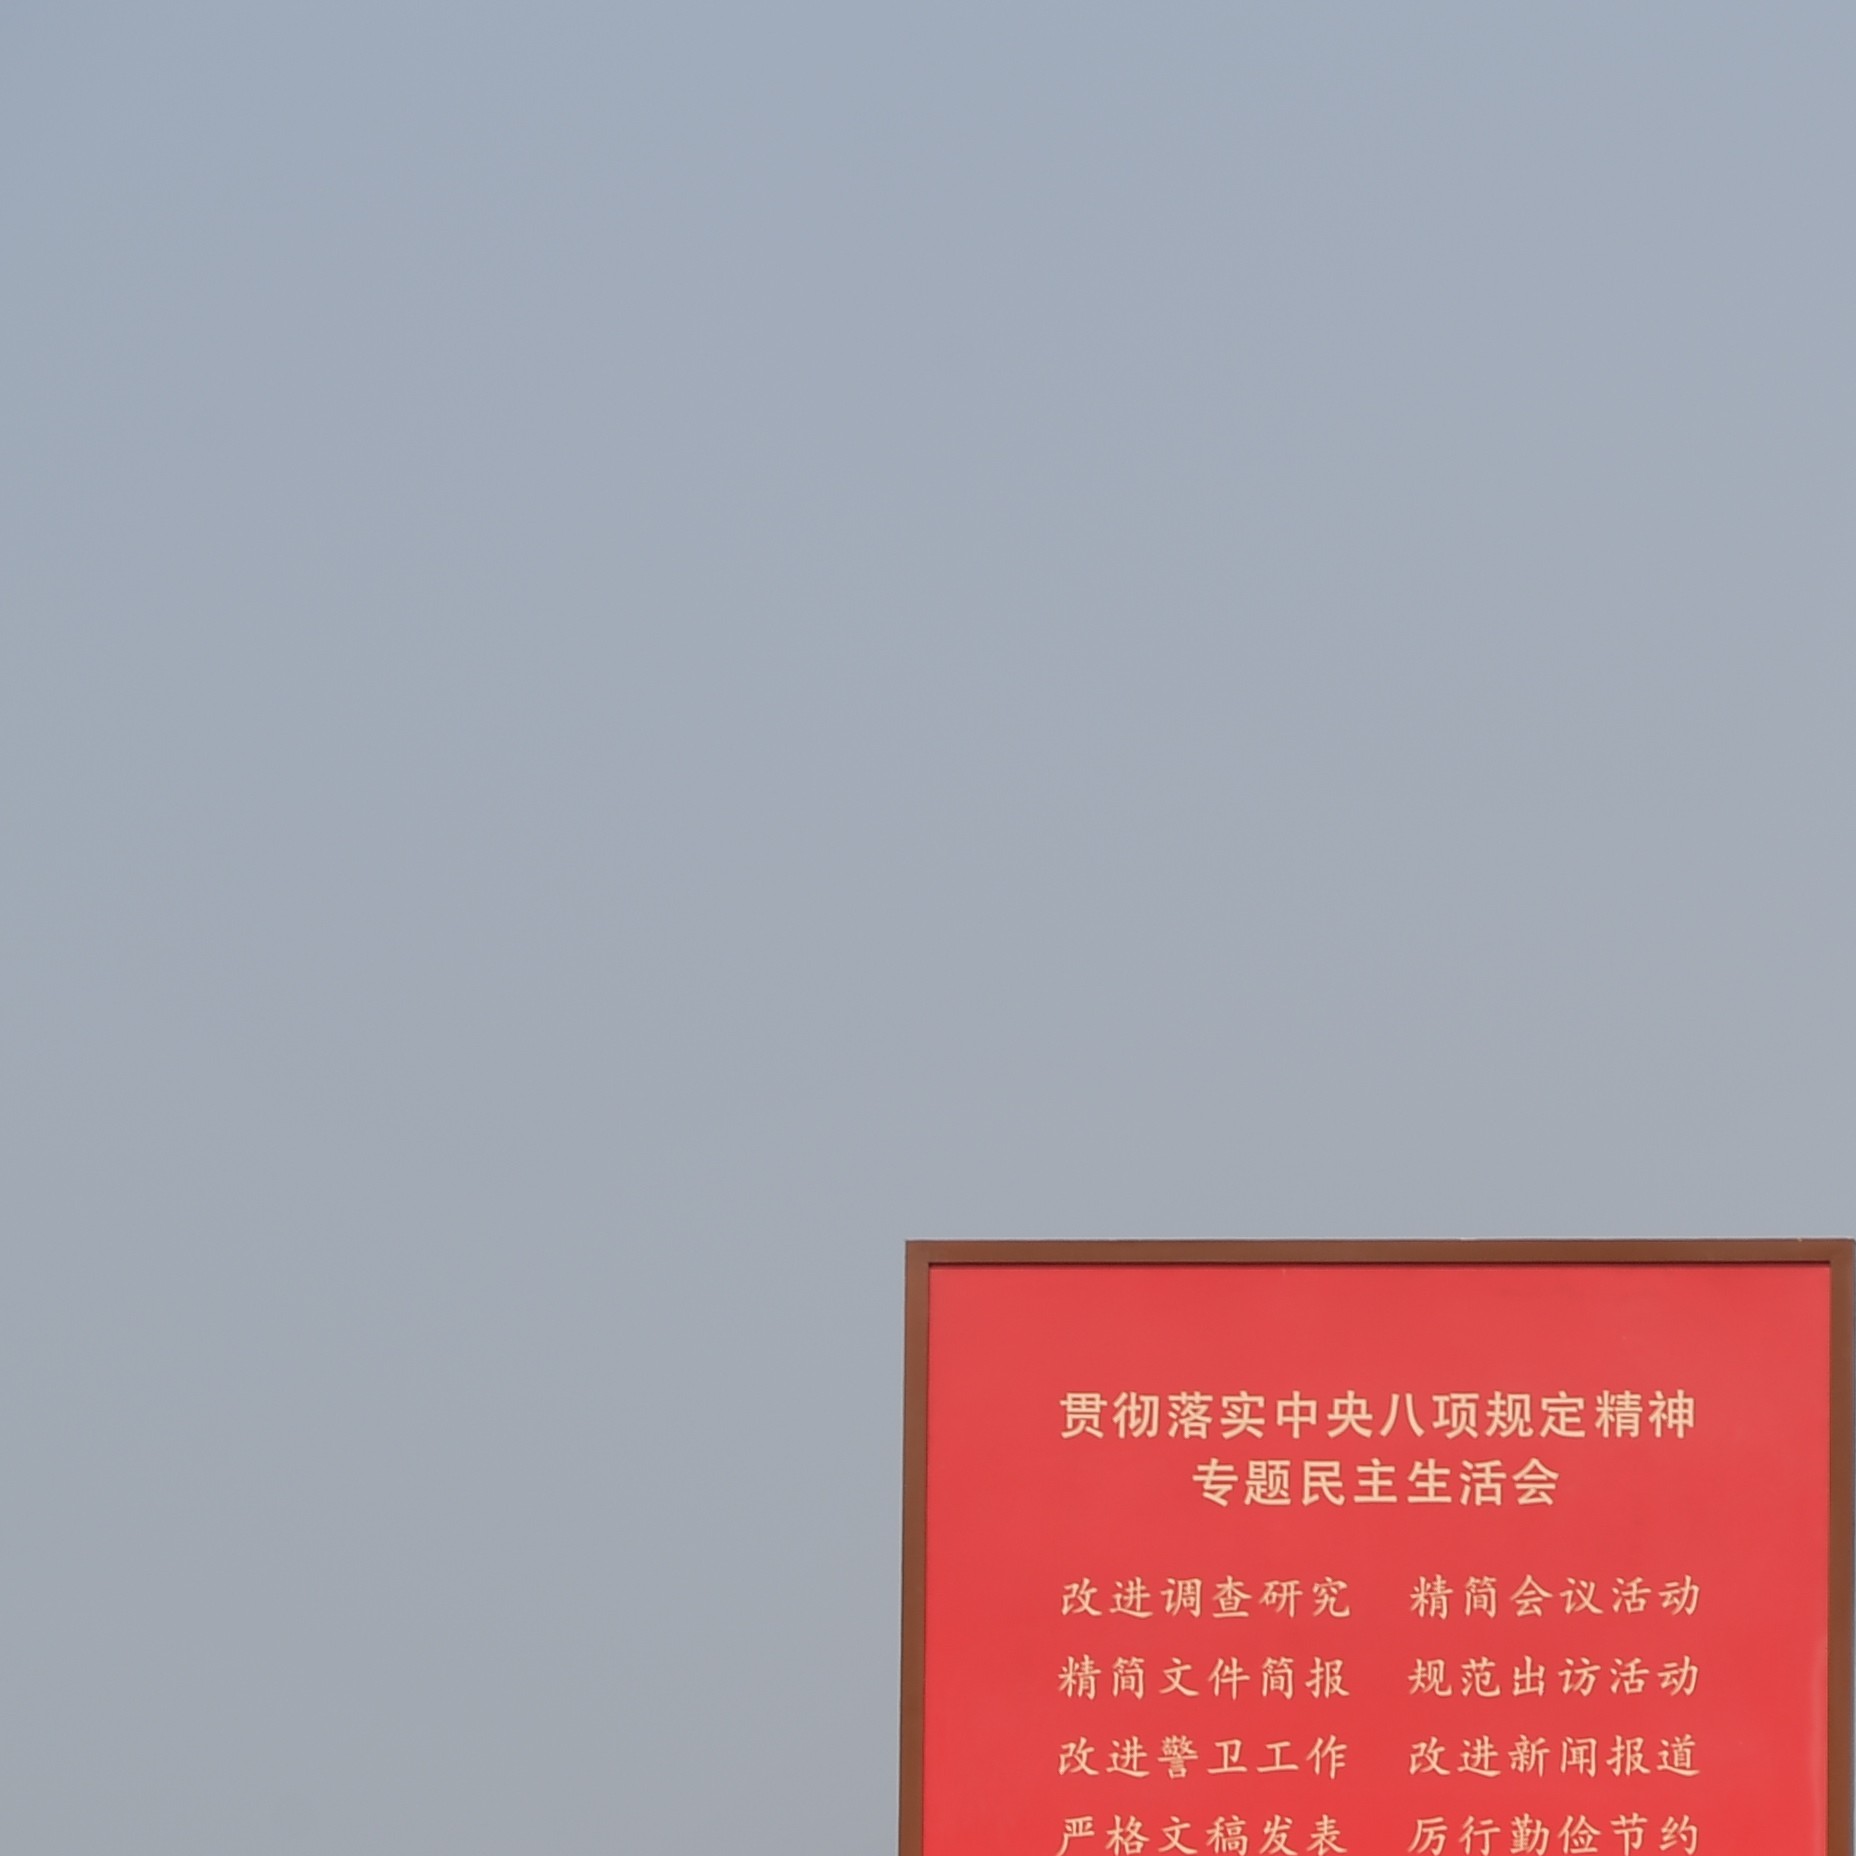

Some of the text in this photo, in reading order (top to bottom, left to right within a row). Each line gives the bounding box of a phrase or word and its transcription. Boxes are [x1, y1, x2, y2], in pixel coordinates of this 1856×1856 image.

[1059, 1389, 1696, 1440] 贯彻落实中央八项规定精神
[1192, 1457, 1560, 1507] 专题民主生活会
[1057, 1574, 1700, 1620] 改进调查研究 精简会议活动
[1057, 1655, 1700, 1700] 精简文件简报 规范出访活动
[1057, 1733, 1700, 1779] 改进警卫工作 改进新闻报道
[1408, 1812, 1700, 1856] 厉行勤俭节约
